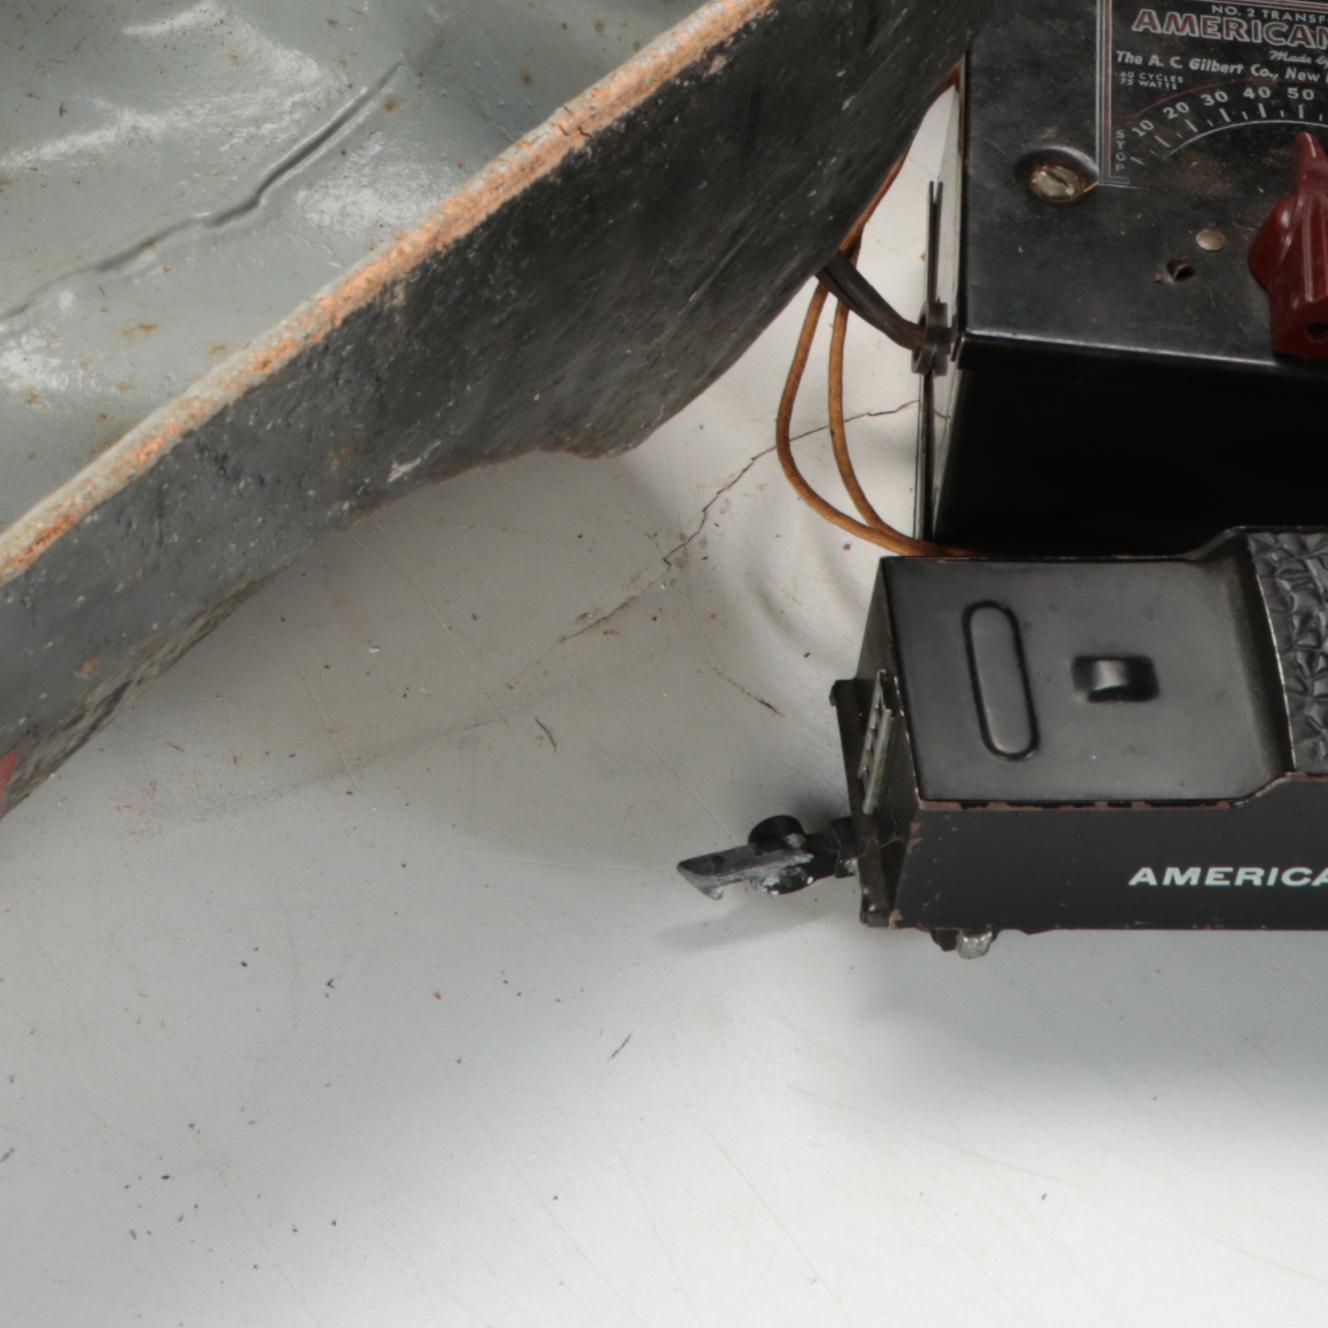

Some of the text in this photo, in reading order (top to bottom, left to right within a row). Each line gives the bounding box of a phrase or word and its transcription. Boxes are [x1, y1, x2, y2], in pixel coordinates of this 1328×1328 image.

[1212, 4, 1328, 24] NO. 2 TRANSF
[1116, 49, 1144, 66] The
[1188, 57, 1245, 75] Gilbert
[1285, 66, 1321, 83] New
[1138, 72, 1184, 84] CYCLES
[1138, 79, 1178, 90] WATTS
[1200, 90, 1229, 107] 30
[1243, 85, 1272, 100] 40
[1287, 86, 1315, 101] 50
[1162, 101, 1190, 120] 20
[1132, 119, 1155, 138] 10
[1115, 129, 1126, 172] STOP
